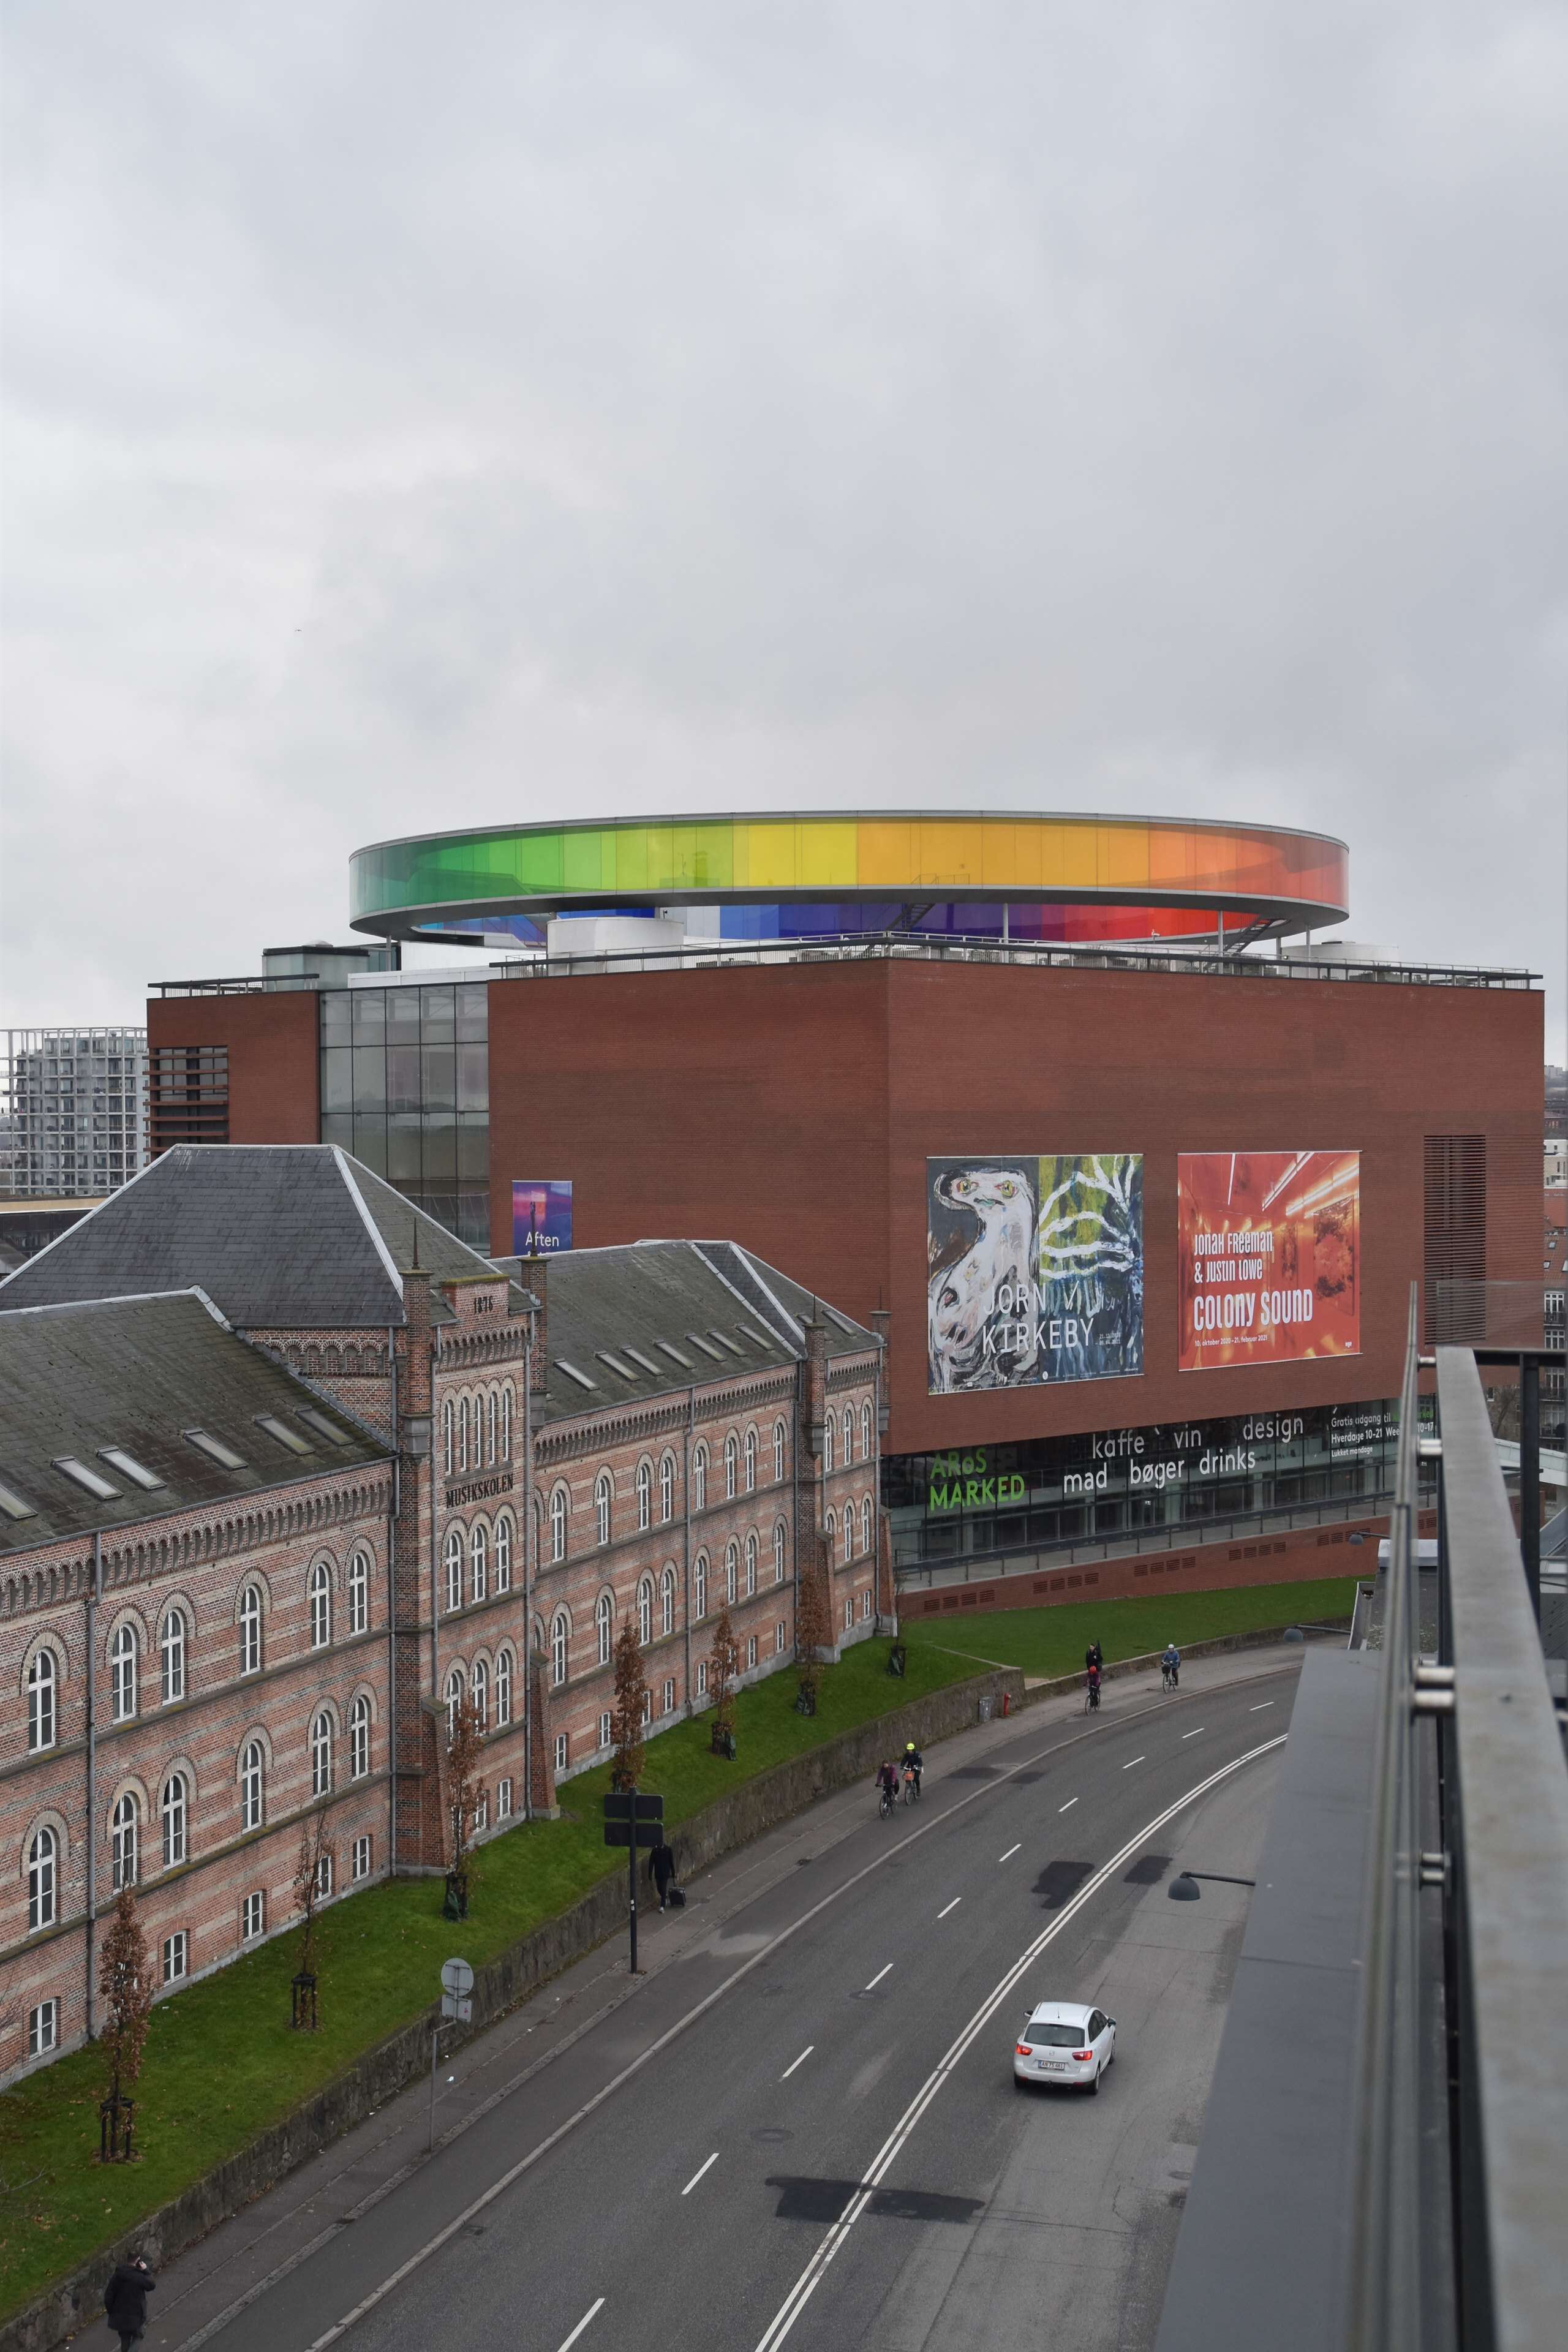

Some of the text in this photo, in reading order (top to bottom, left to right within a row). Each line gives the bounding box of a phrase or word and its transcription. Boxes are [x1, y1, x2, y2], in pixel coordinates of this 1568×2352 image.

[526, 1231, 559, 1246] Aften
[1194, 1262, 1203, 1283] &
[984, 1283, 1046, 1315] JORN
[982, 1317, 1094, 1354] KIRKEBY
[1093, 1413, 1303, 1459] kaffe vin design
[1331, 1431, 1364, 1444] Hverdage
[1365, 1428, 1382, 1440] 10-21
[1417, 1422, 1434, 1433] 10-17
[1332, 1415, 1353, 1428] Gratis
[930, 1447, 987, 1479] ARoS
[1332, 1446, 1373, 1457] Lukket mandage
[1064, 1446, 1255, 1493] mad bøger drinks
[446, 1473, 513, 1509] MUSIKSKOLEN
[930, 1474, 1025, 1511] MARKED
